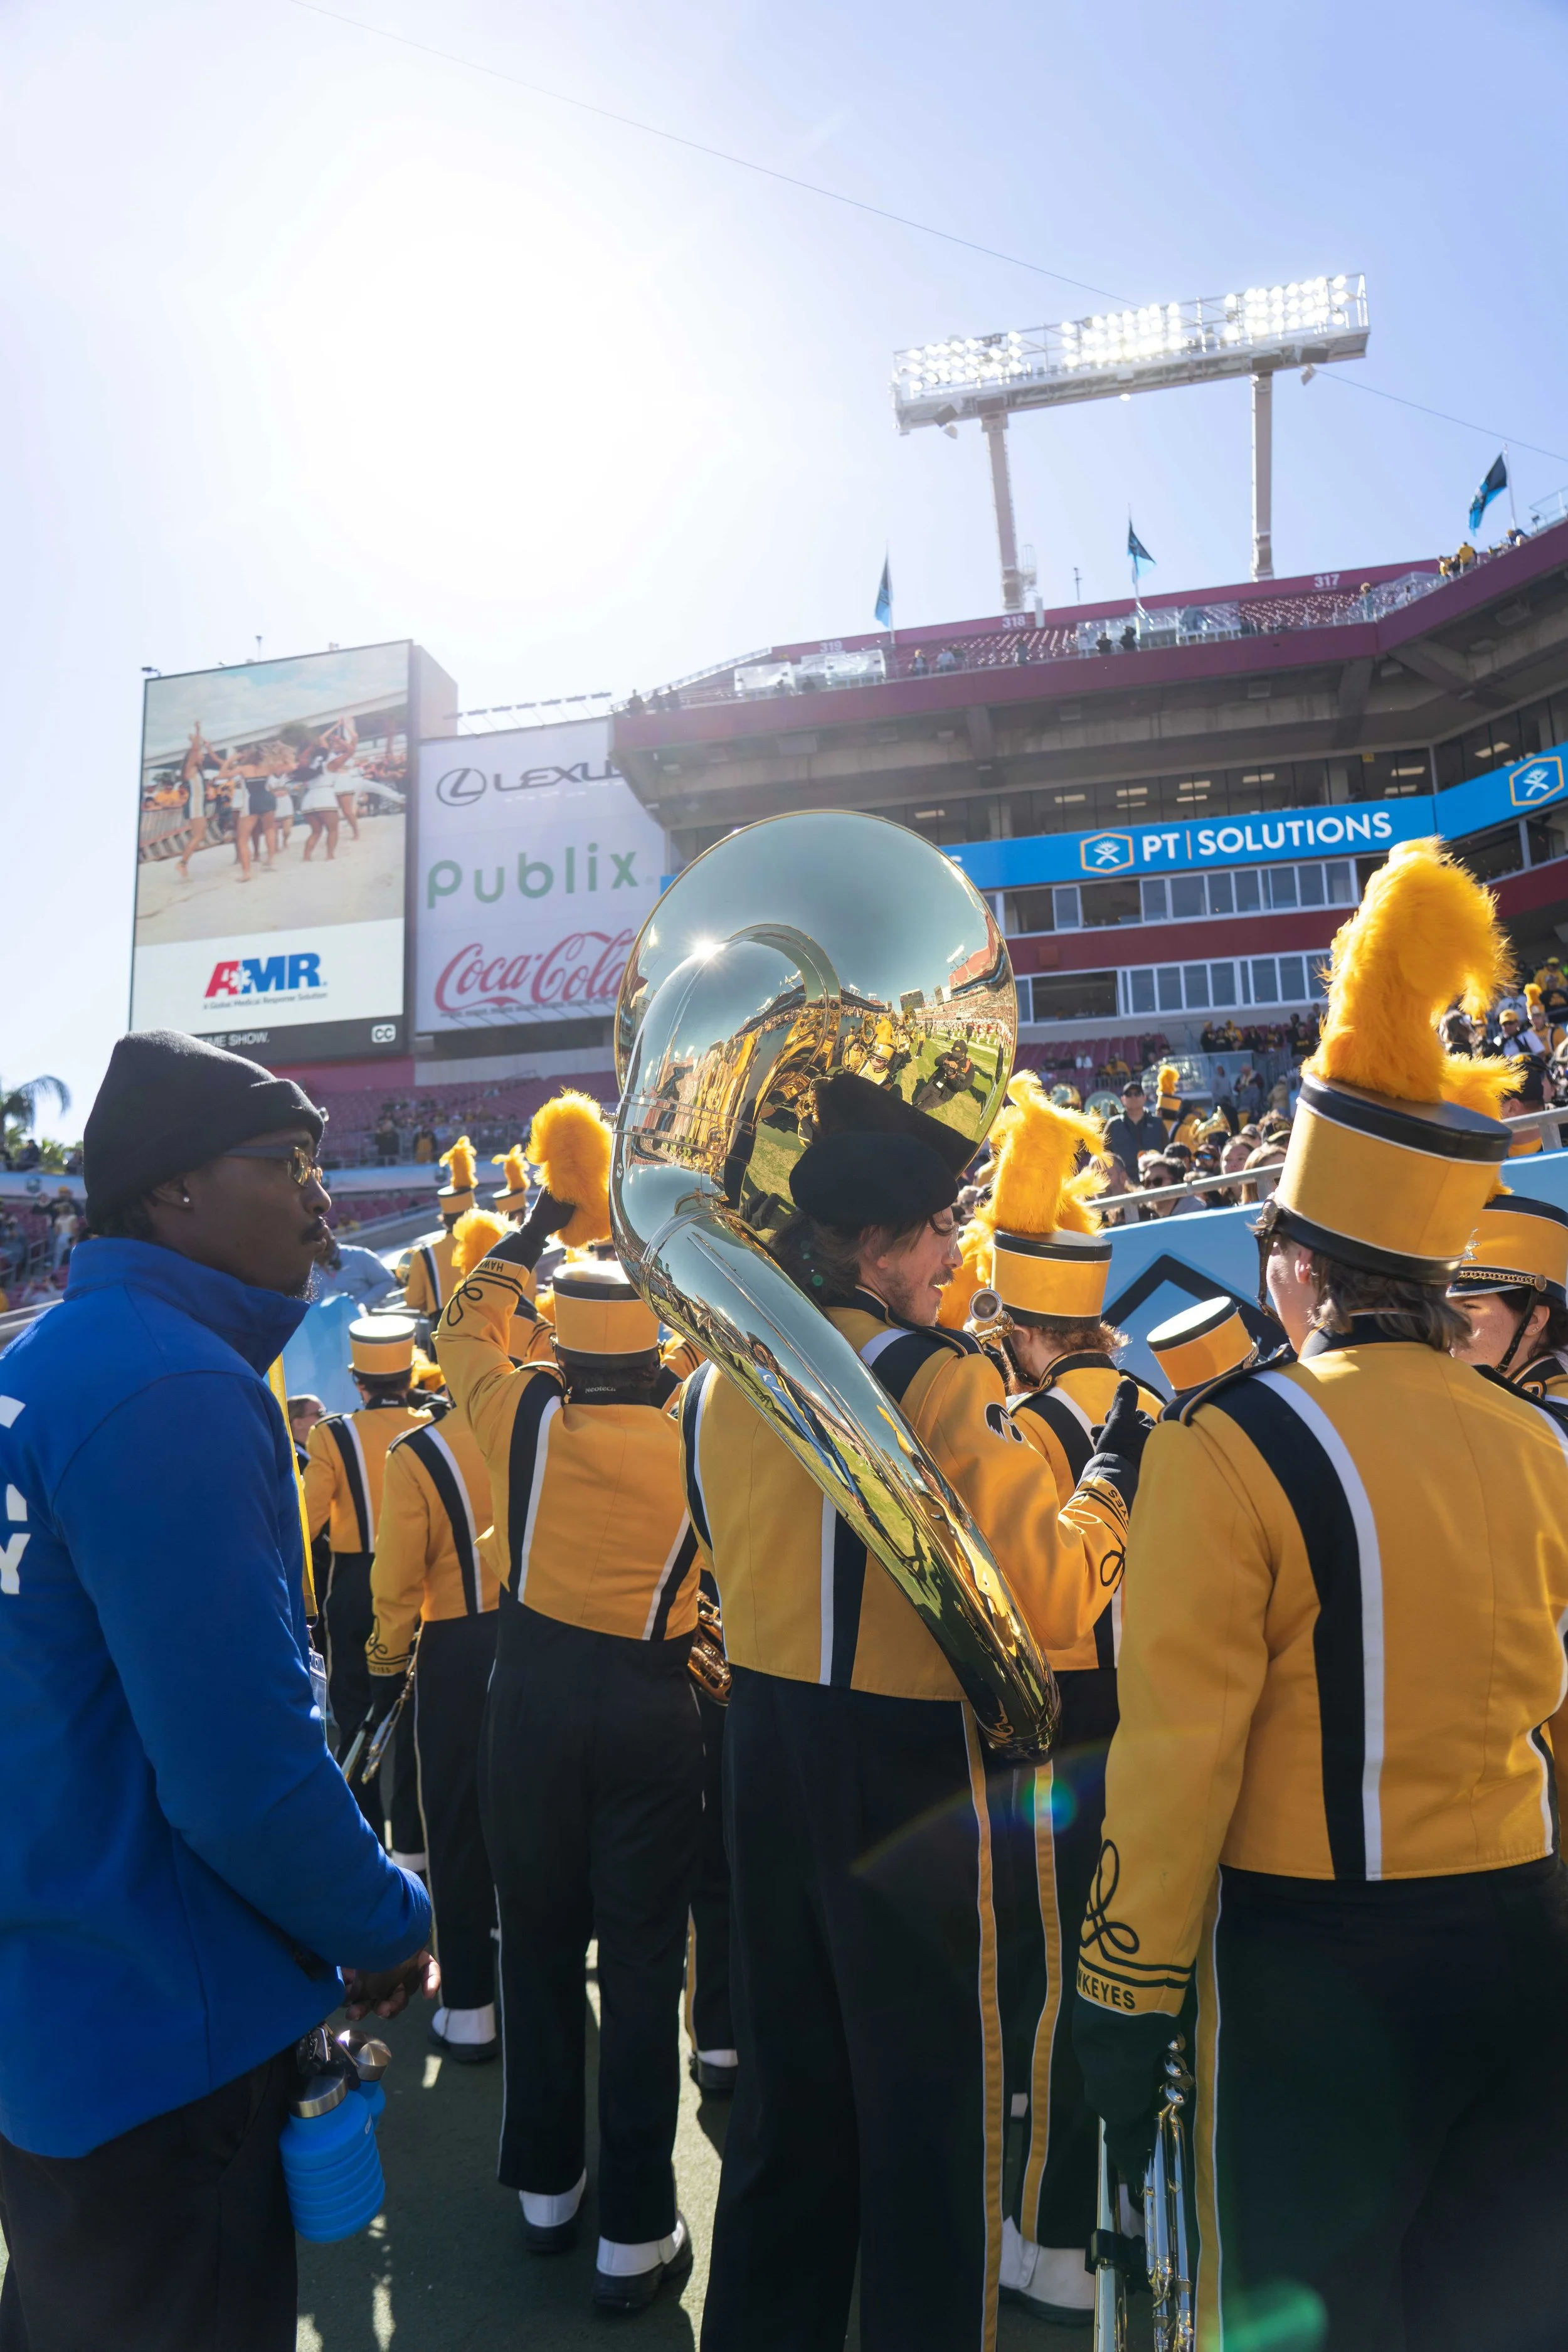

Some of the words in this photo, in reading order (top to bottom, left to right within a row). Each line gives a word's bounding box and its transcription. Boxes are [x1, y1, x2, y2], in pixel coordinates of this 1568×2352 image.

[1314, 573, 1340, 588] 317
[1002, 615, 1026, 628] 318
[819, 640, 843, 653] 319
[493, 760, 626, 792] LEXU
[1142, 832, 1180, 862] PT
[1197, 811, 1393, 857] SOLUTIONS
[204, 952, 321, 999] AMR
